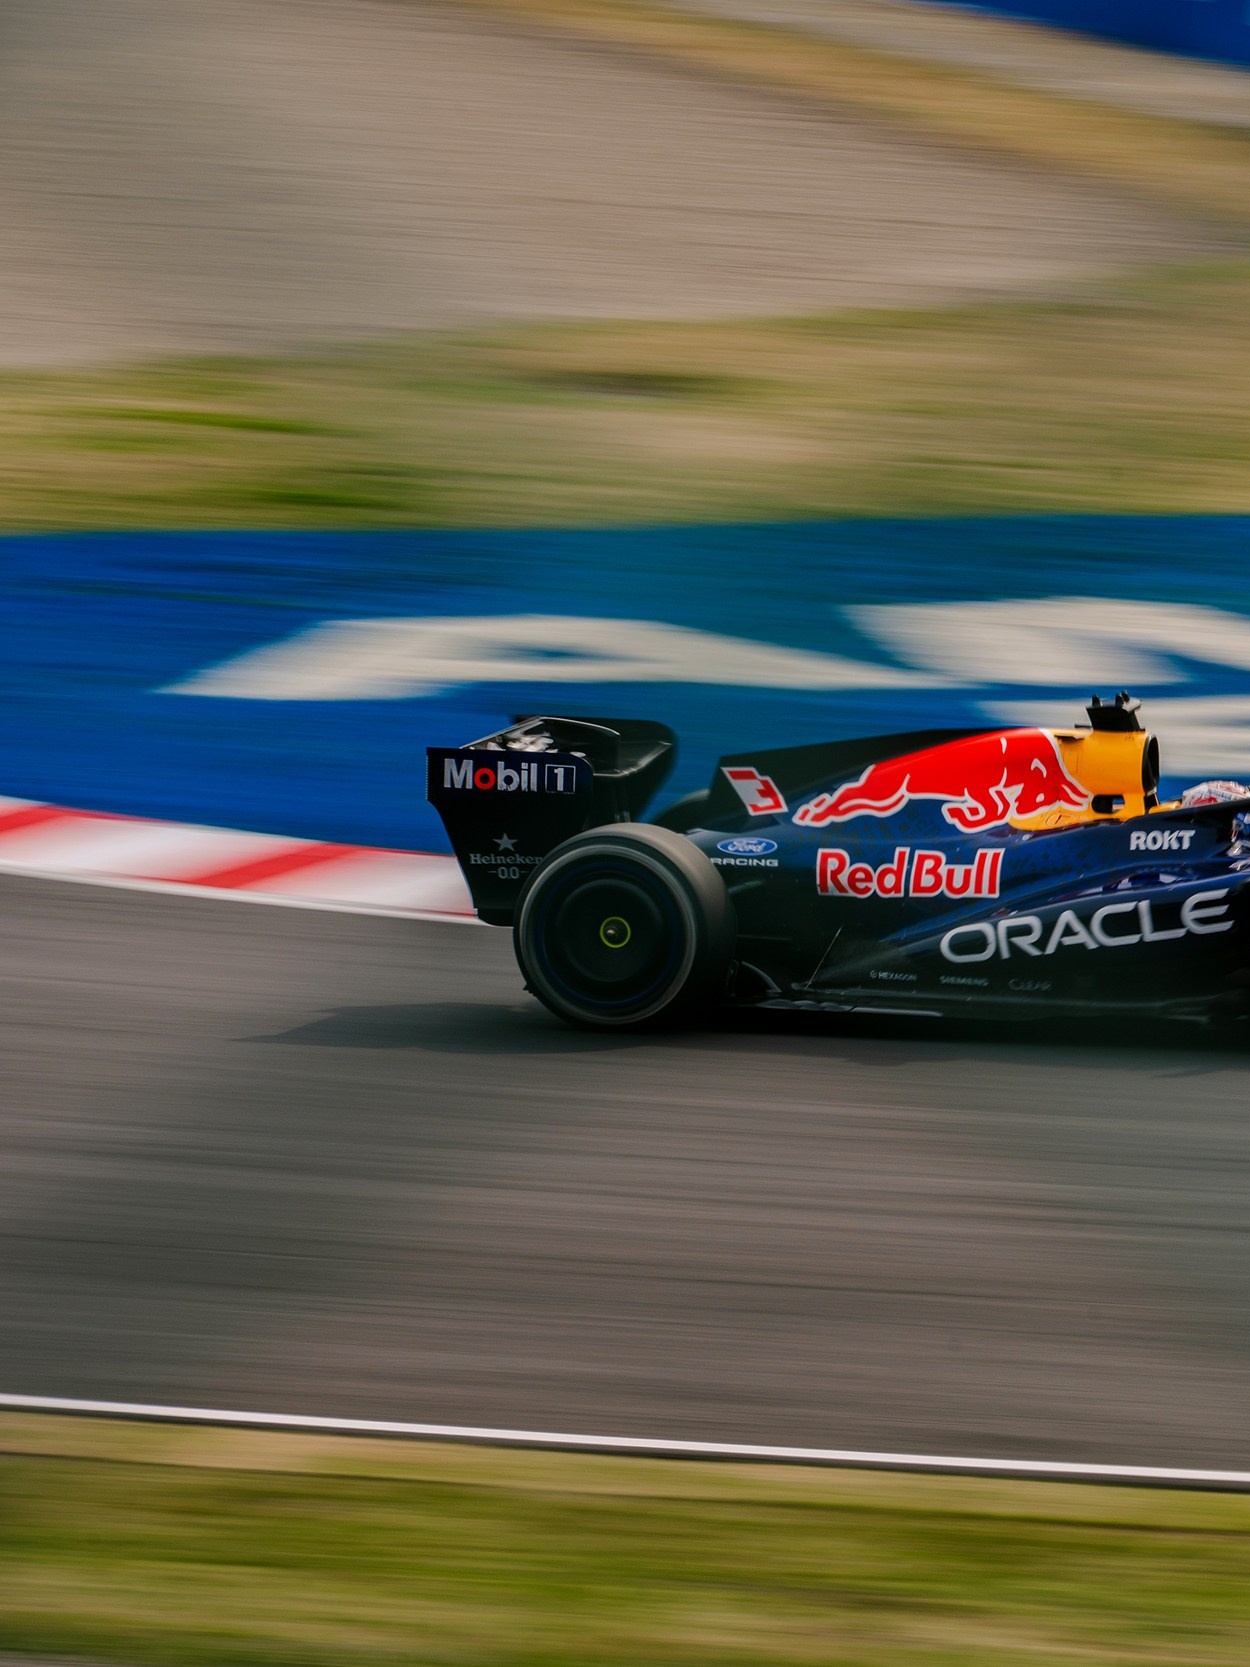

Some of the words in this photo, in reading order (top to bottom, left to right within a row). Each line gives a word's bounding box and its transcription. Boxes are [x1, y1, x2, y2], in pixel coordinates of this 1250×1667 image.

[443, 757, 538, 792] Mobil
[721, 767, 788, 815] 3
[1129, 829, 1196, 851] ROKT
[710, 857, 779, 867] RACING
[816, 847, 910, 898] Red
[909, 849, 1005, 898] Bull
[940, 889, 1234, 963] ORACLE
